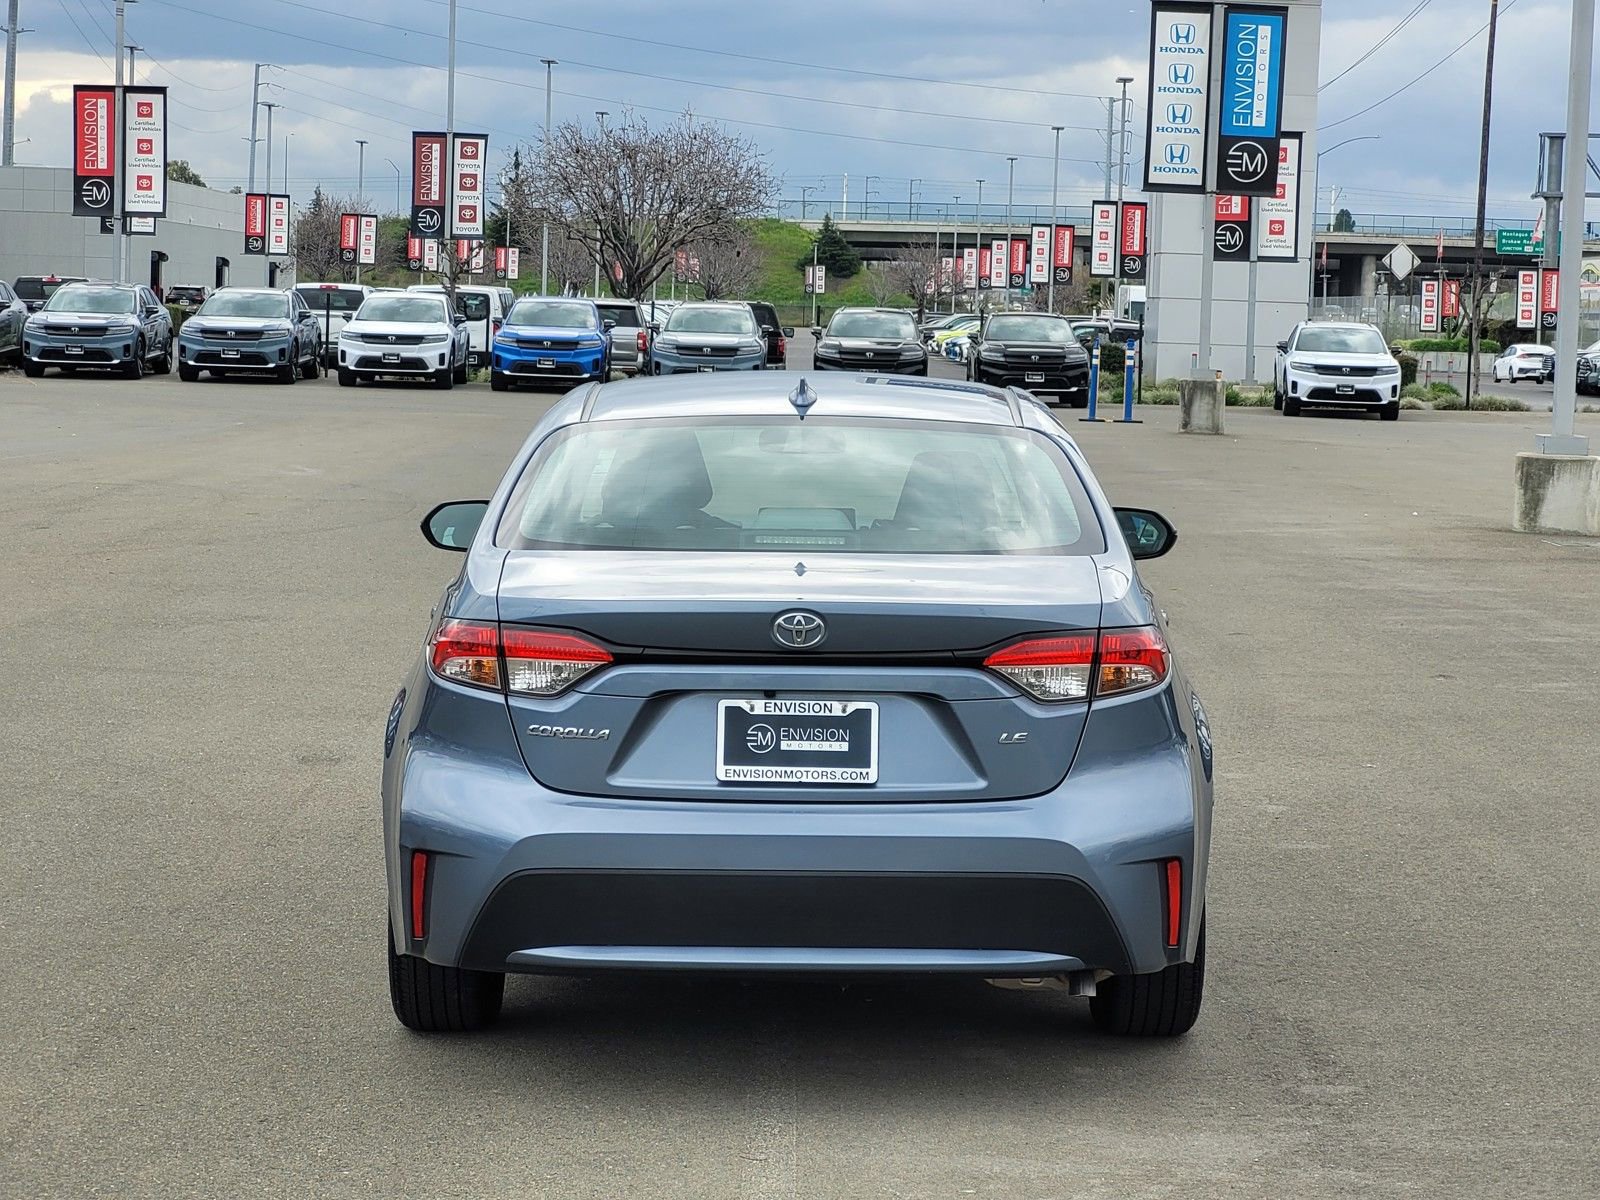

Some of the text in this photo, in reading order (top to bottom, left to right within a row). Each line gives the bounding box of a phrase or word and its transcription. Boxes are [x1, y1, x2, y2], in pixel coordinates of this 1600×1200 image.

[1159, 46, 1205, 54] HONDA
[1232, 23, 1257, 127] ENVISION
[1256, 34, 1268, 118] MOTORS
[1157, 86, 1203, 94] HONDA
[84, 98, 97, 169] ENVISION
[1155, 126, 1201, 134] HONDA
[420, 142, 432, 201] ENVISION
[1152, 166, 1199, 174] HONDA
[1126, 209, 1136, 251] ENVISION
[1057, 230, 1065, 263] ENVISION
[1544, 273, 1552, 309] ENVISION
[764, 702, 833, 714] ENVISION
[527, 724, 610, 740] COROLLA
[780, 728, 849, 741] ENVISION
[998, 732, 1029, 744] LE
[724, 769, 870, 781] ENVISIONMOTORS.COM
